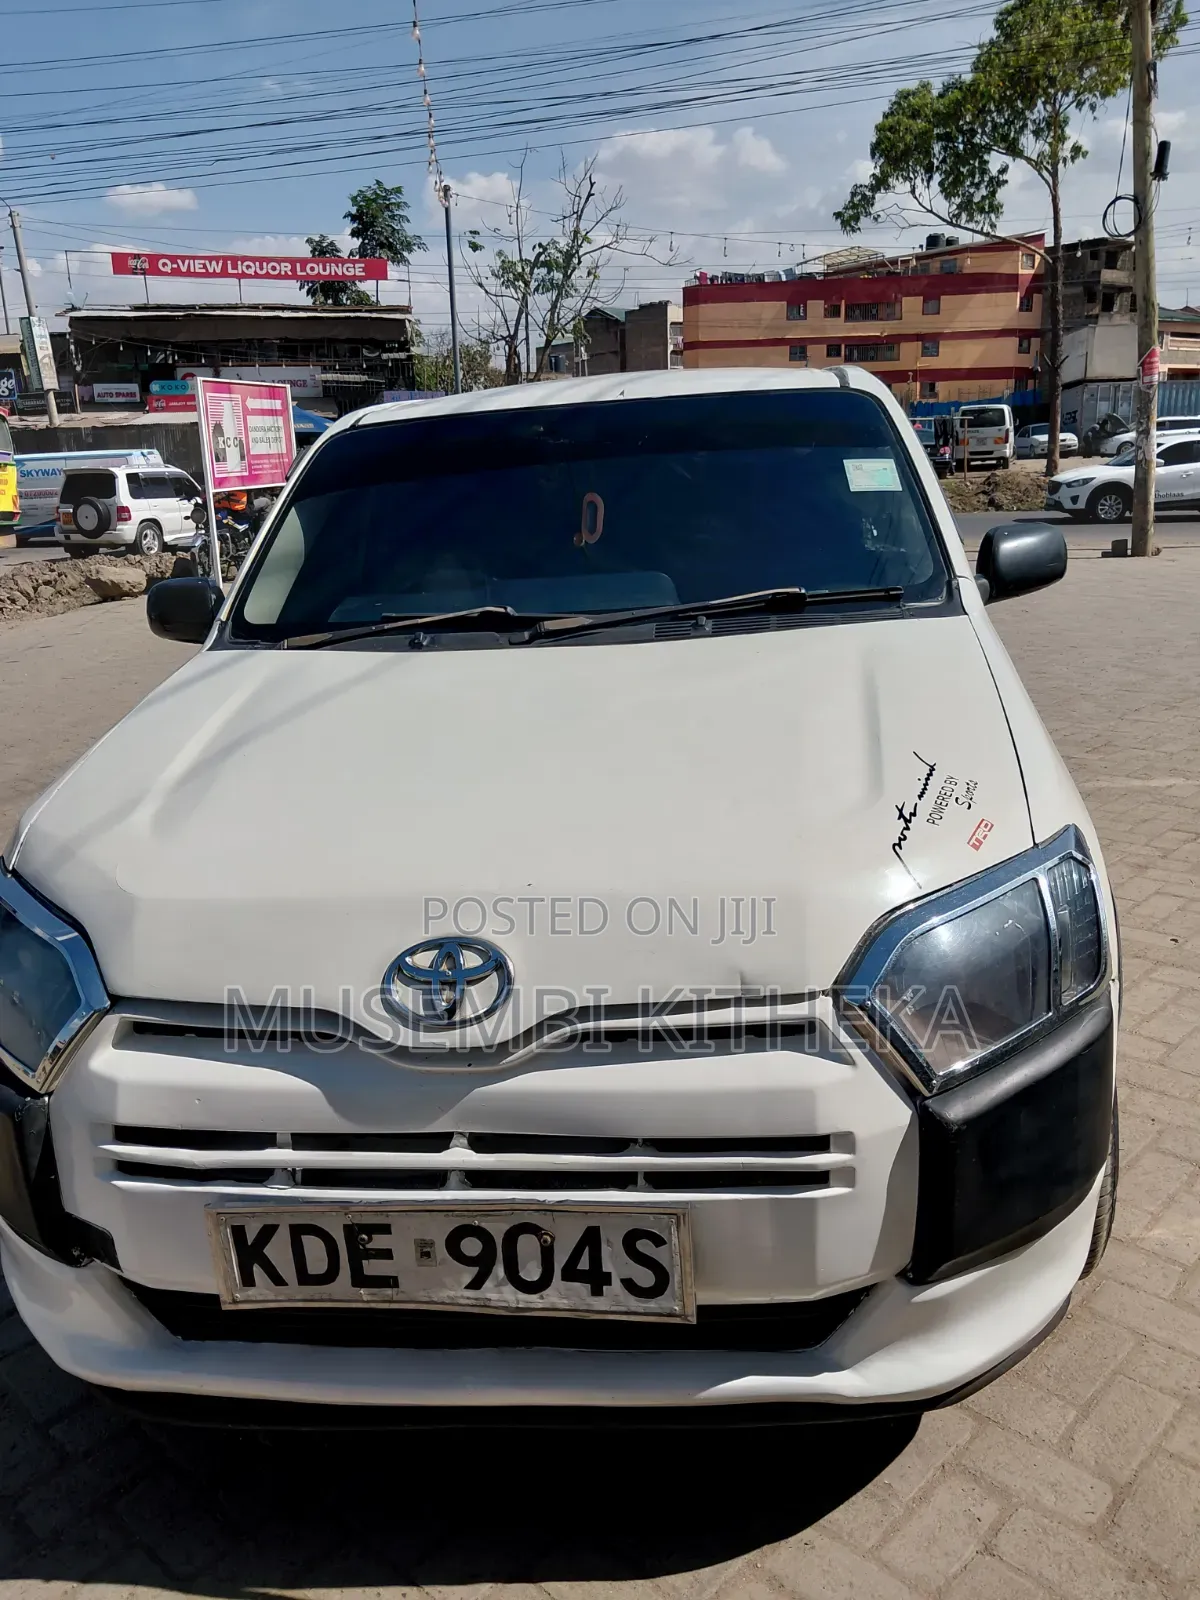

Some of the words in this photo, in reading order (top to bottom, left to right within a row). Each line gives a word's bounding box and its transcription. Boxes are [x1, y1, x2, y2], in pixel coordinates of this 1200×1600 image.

[158, 258, 223, 273] Q-VIEW
[227, 260, 293, 275] LIQUOR
[296, 263, 366, 276] LOUNGE
[20, 468, 63, 477] SKYWAY
[926, 784, 954, 826] POWERED
[945, 774, 959, 787] BY
[955, 779, 979, 810] Sports
[967, 818, 994, 851] TRD
[230, 1223, 400, 1289] KDE
[444, 1221, 672, 1300] 904S
